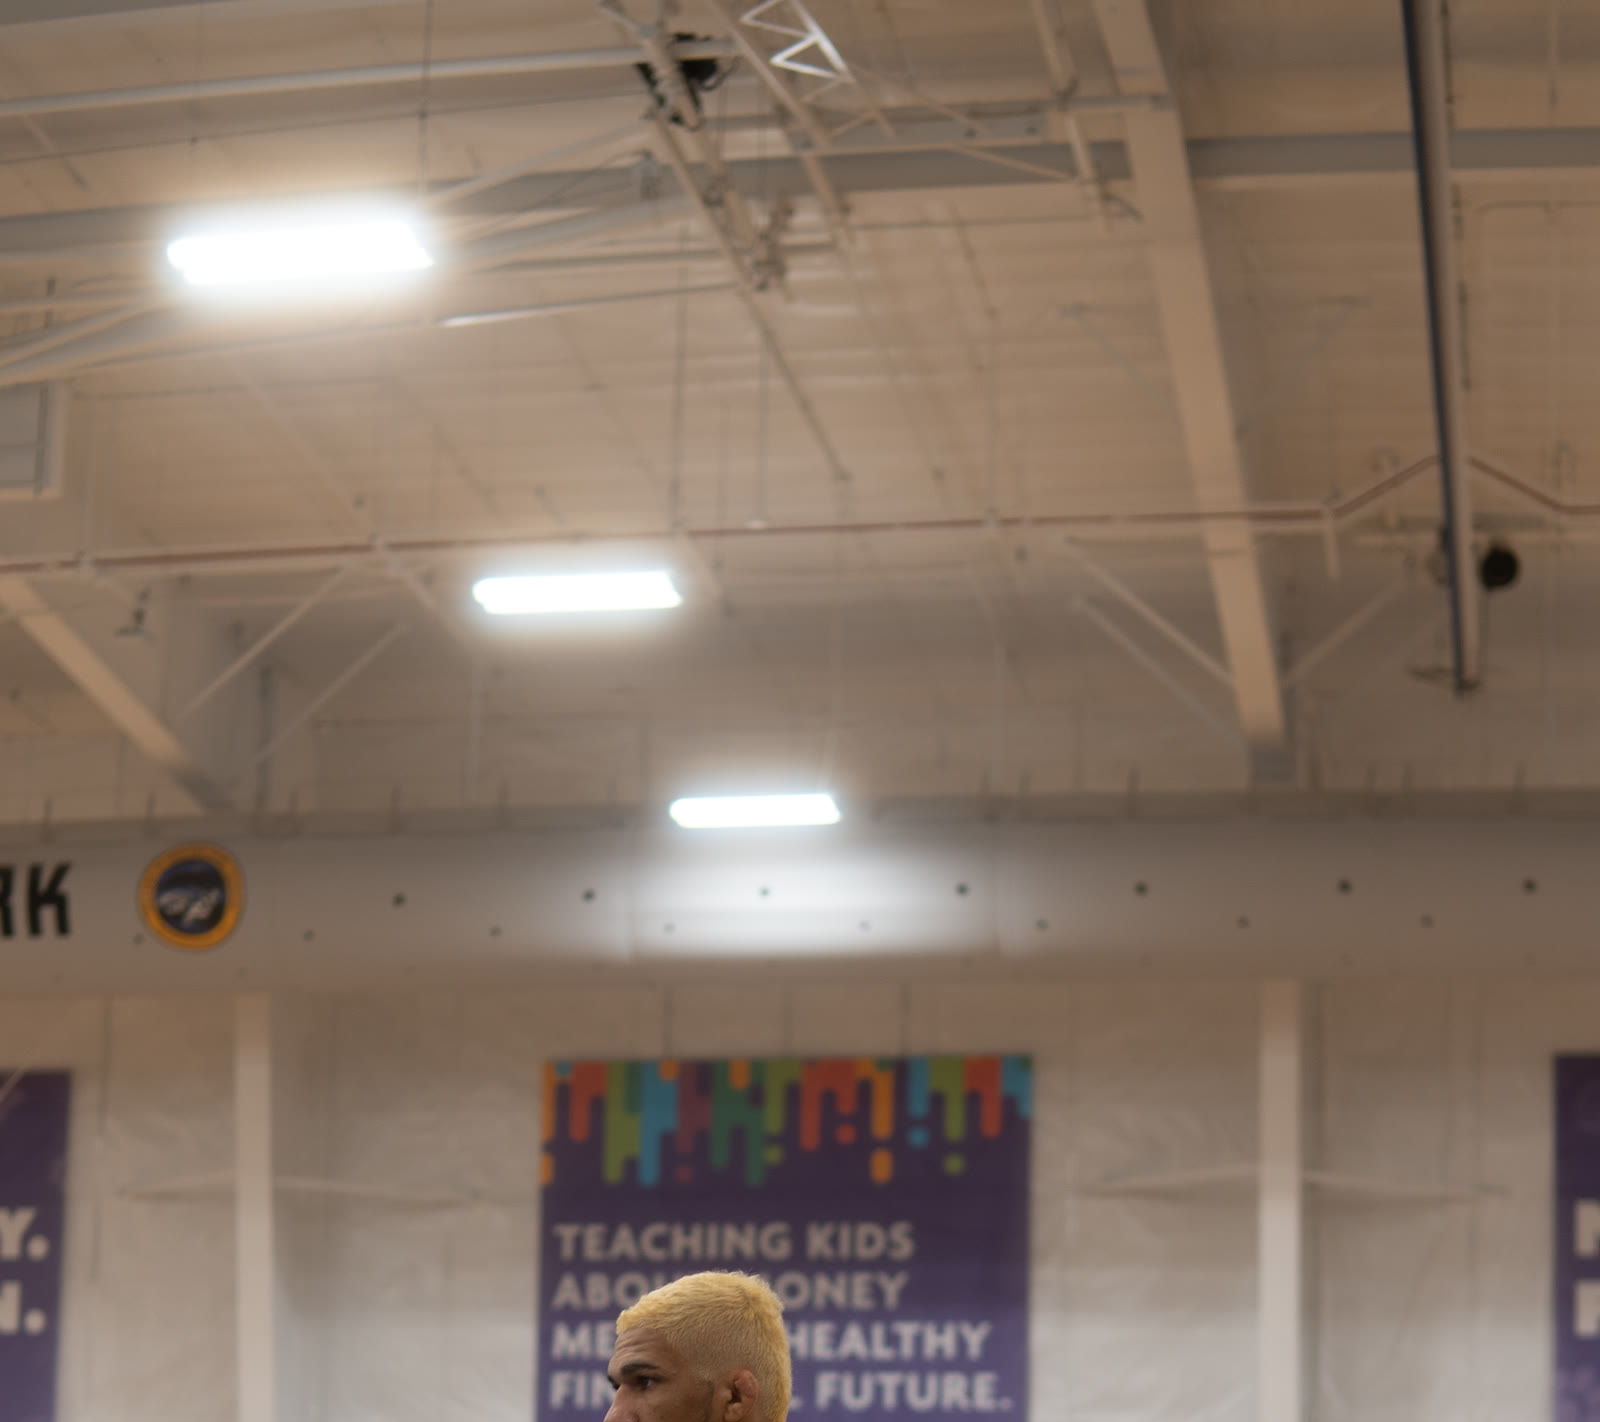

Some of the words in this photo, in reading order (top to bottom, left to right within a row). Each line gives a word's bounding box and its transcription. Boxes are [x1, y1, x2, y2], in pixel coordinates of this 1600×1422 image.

[553, 1222, 792, 1260] TEACHING
[806, 1221, 915, 1260] KIDS
[553, 1272, 682, 1311] ABO
[768, 1271, 909, 1311] ONEY
[784, 1320, 992, 1361] HEALTHY
[815, 1370, 1013, 1412] FUTURE.
